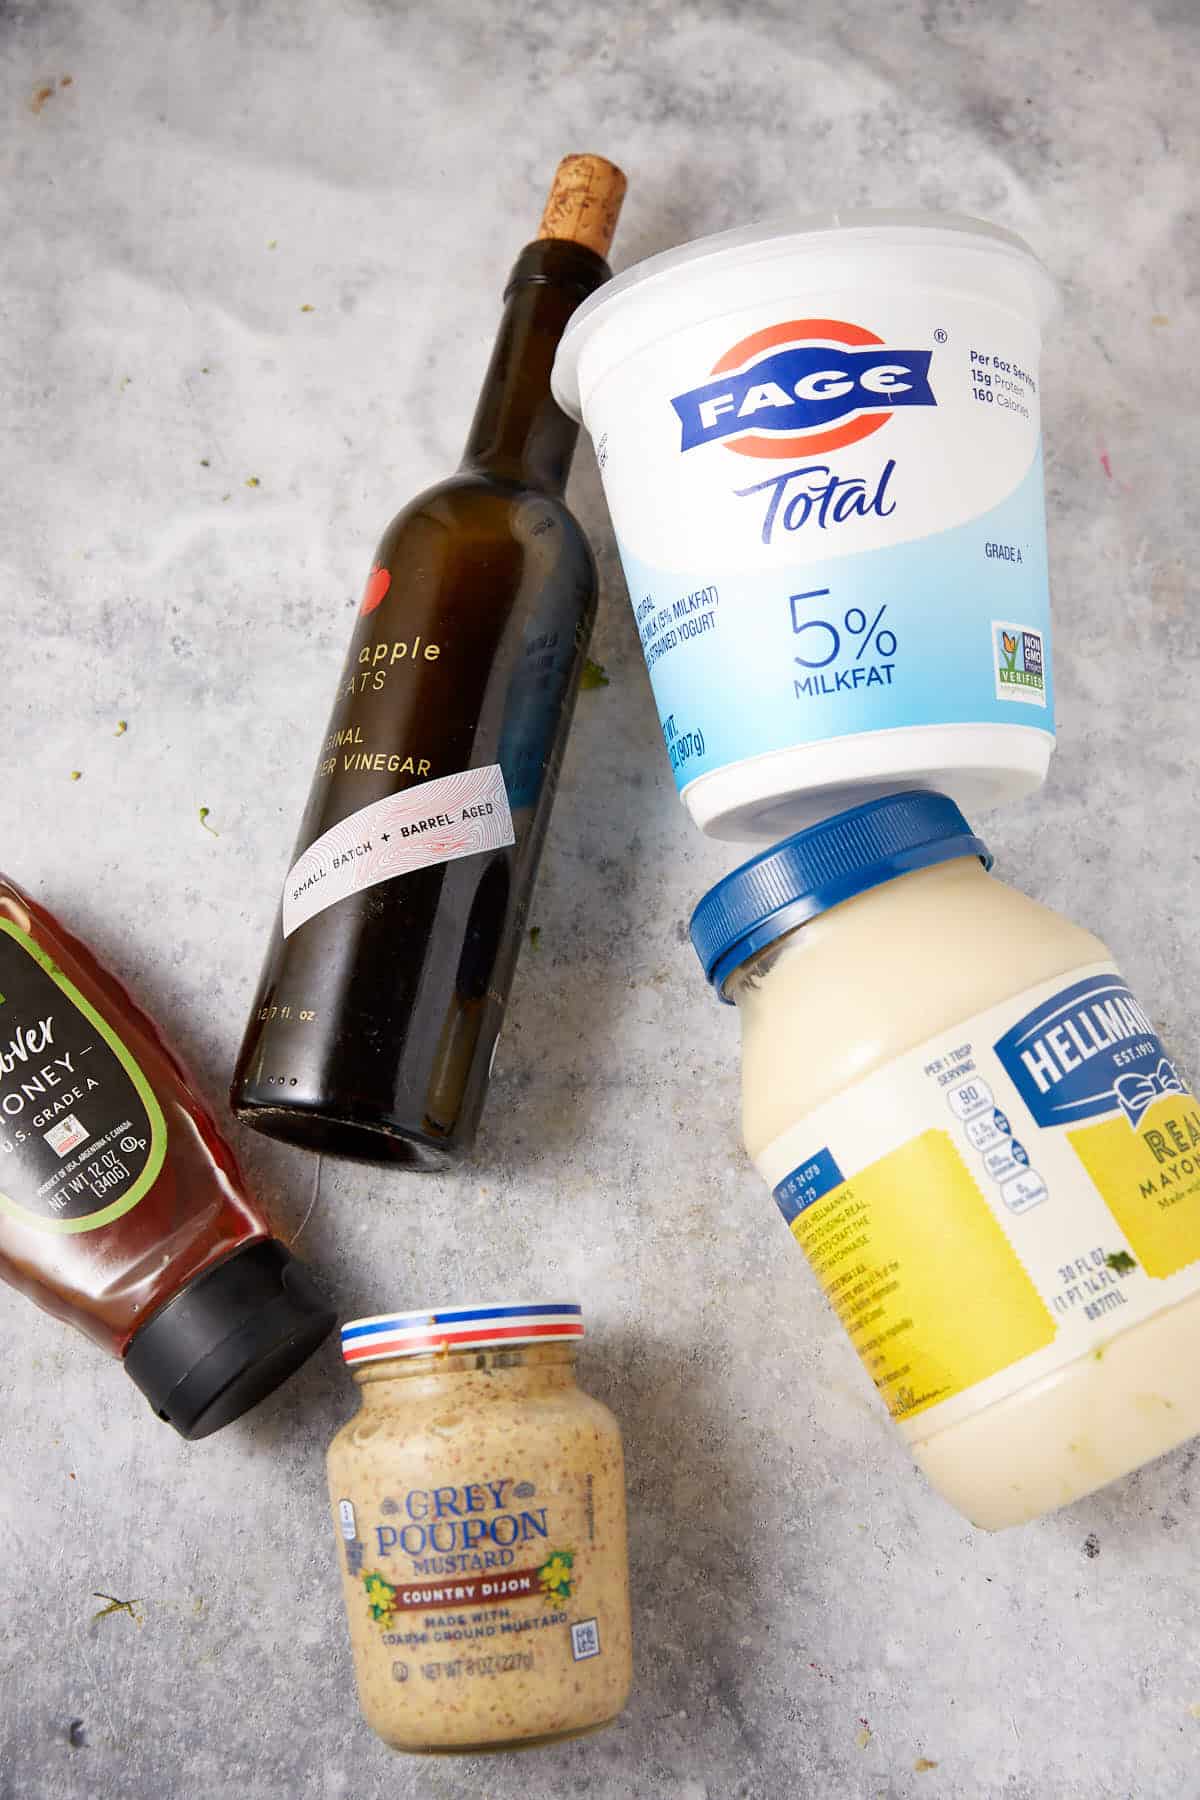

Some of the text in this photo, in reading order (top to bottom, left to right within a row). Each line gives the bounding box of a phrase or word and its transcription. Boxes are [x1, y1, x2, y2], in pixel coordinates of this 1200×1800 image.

[970, 350, 990, 366] Per
[993, 356, 1011, 373] 6oz
[971, 369, 991, 386] 15g
[698, 365, 913, 430] FAGE
[972, 388, 994, 403] 160
[733, 459, 897, 545] Total
[985, 542, 1023, 564] GRADE A
[673, 585, 719, 619] MILKFAT)
[677, 611, 715, 641] YOGURT
[788, 588, 898, 669] 5%
[358, 637, 441, 667] apple
[1024, 635, 1040, 650] NON
[1025, 649, 1041, 663] GMO
[793, 663, 897, 700] MILKFAT
[1001, 671, 1043, 688] VERIFIED
[677, 728, 705, 768] (907g)
[344, 753, 431, 776] VINEGAR
[292, 869, 327, 900] SMALL
[332, 842, 372, 869] BATCH
[400, 813, 454, 837] BARREL
[461, 803, 494, 821] AGED
[299, 1010, 315, 1021] oz
[0, 1016, 54, 1080] over
[0, 1052, 75, 1122] ONEY
[959, 1086, 978, 1106] 90
[1, 1129, 31, 1153] U.S.
[33, 1086, 83, 1127] GRADE
[86, 1078, 100, 1091] A
[1143, 1111, 1200, 1164] REA
[48, 1150, 120, 1212] NET WT 12 OZ
[1066, 1286, 1083, 1304] PT
[405, 1478, 514, 1520] GREY
[375, 1507, 549, 1557] POUPON
[412, 1548, 514, 1576] MUSTARD
[402, 1577, 531, 1606] COUNTRY DIJON
[382, 1611, 569, 1646] COARSE GROUND MUSTARD
[424, 1608, 511, 1629] MADE WITH
